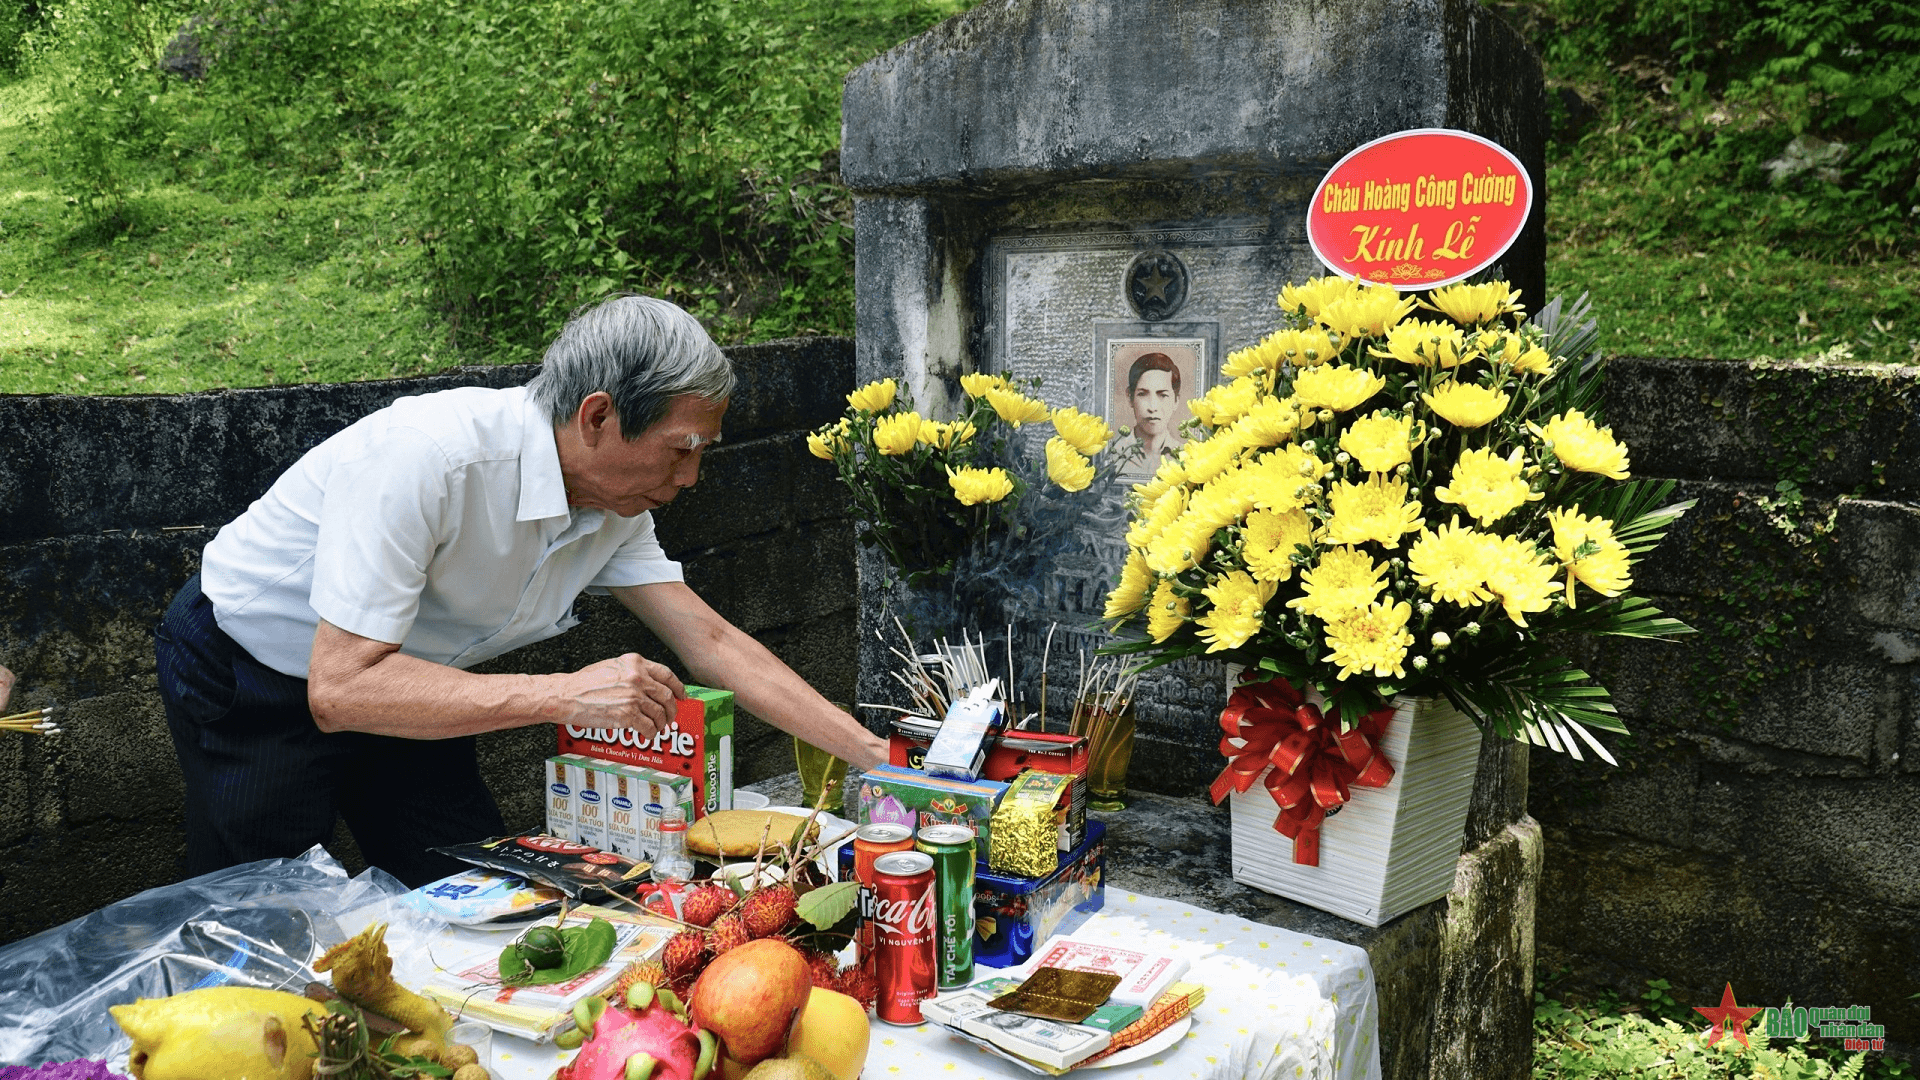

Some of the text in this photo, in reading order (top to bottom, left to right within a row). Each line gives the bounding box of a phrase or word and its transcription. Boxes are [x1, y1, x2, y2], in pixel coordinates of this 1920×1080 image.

[1323, 166, 1516, 213] Cháu Hoàng Công Cường
[1343, 215, 1481, 262] Kính Lễ
[605, 746, 630, 759] ChocoPie
[707, 754, 717, 811] ChocoPie
[889, 936, 924, 946] NGUYÊN
[943, 914, 956, 983] TÁI CHẾ TÔI
